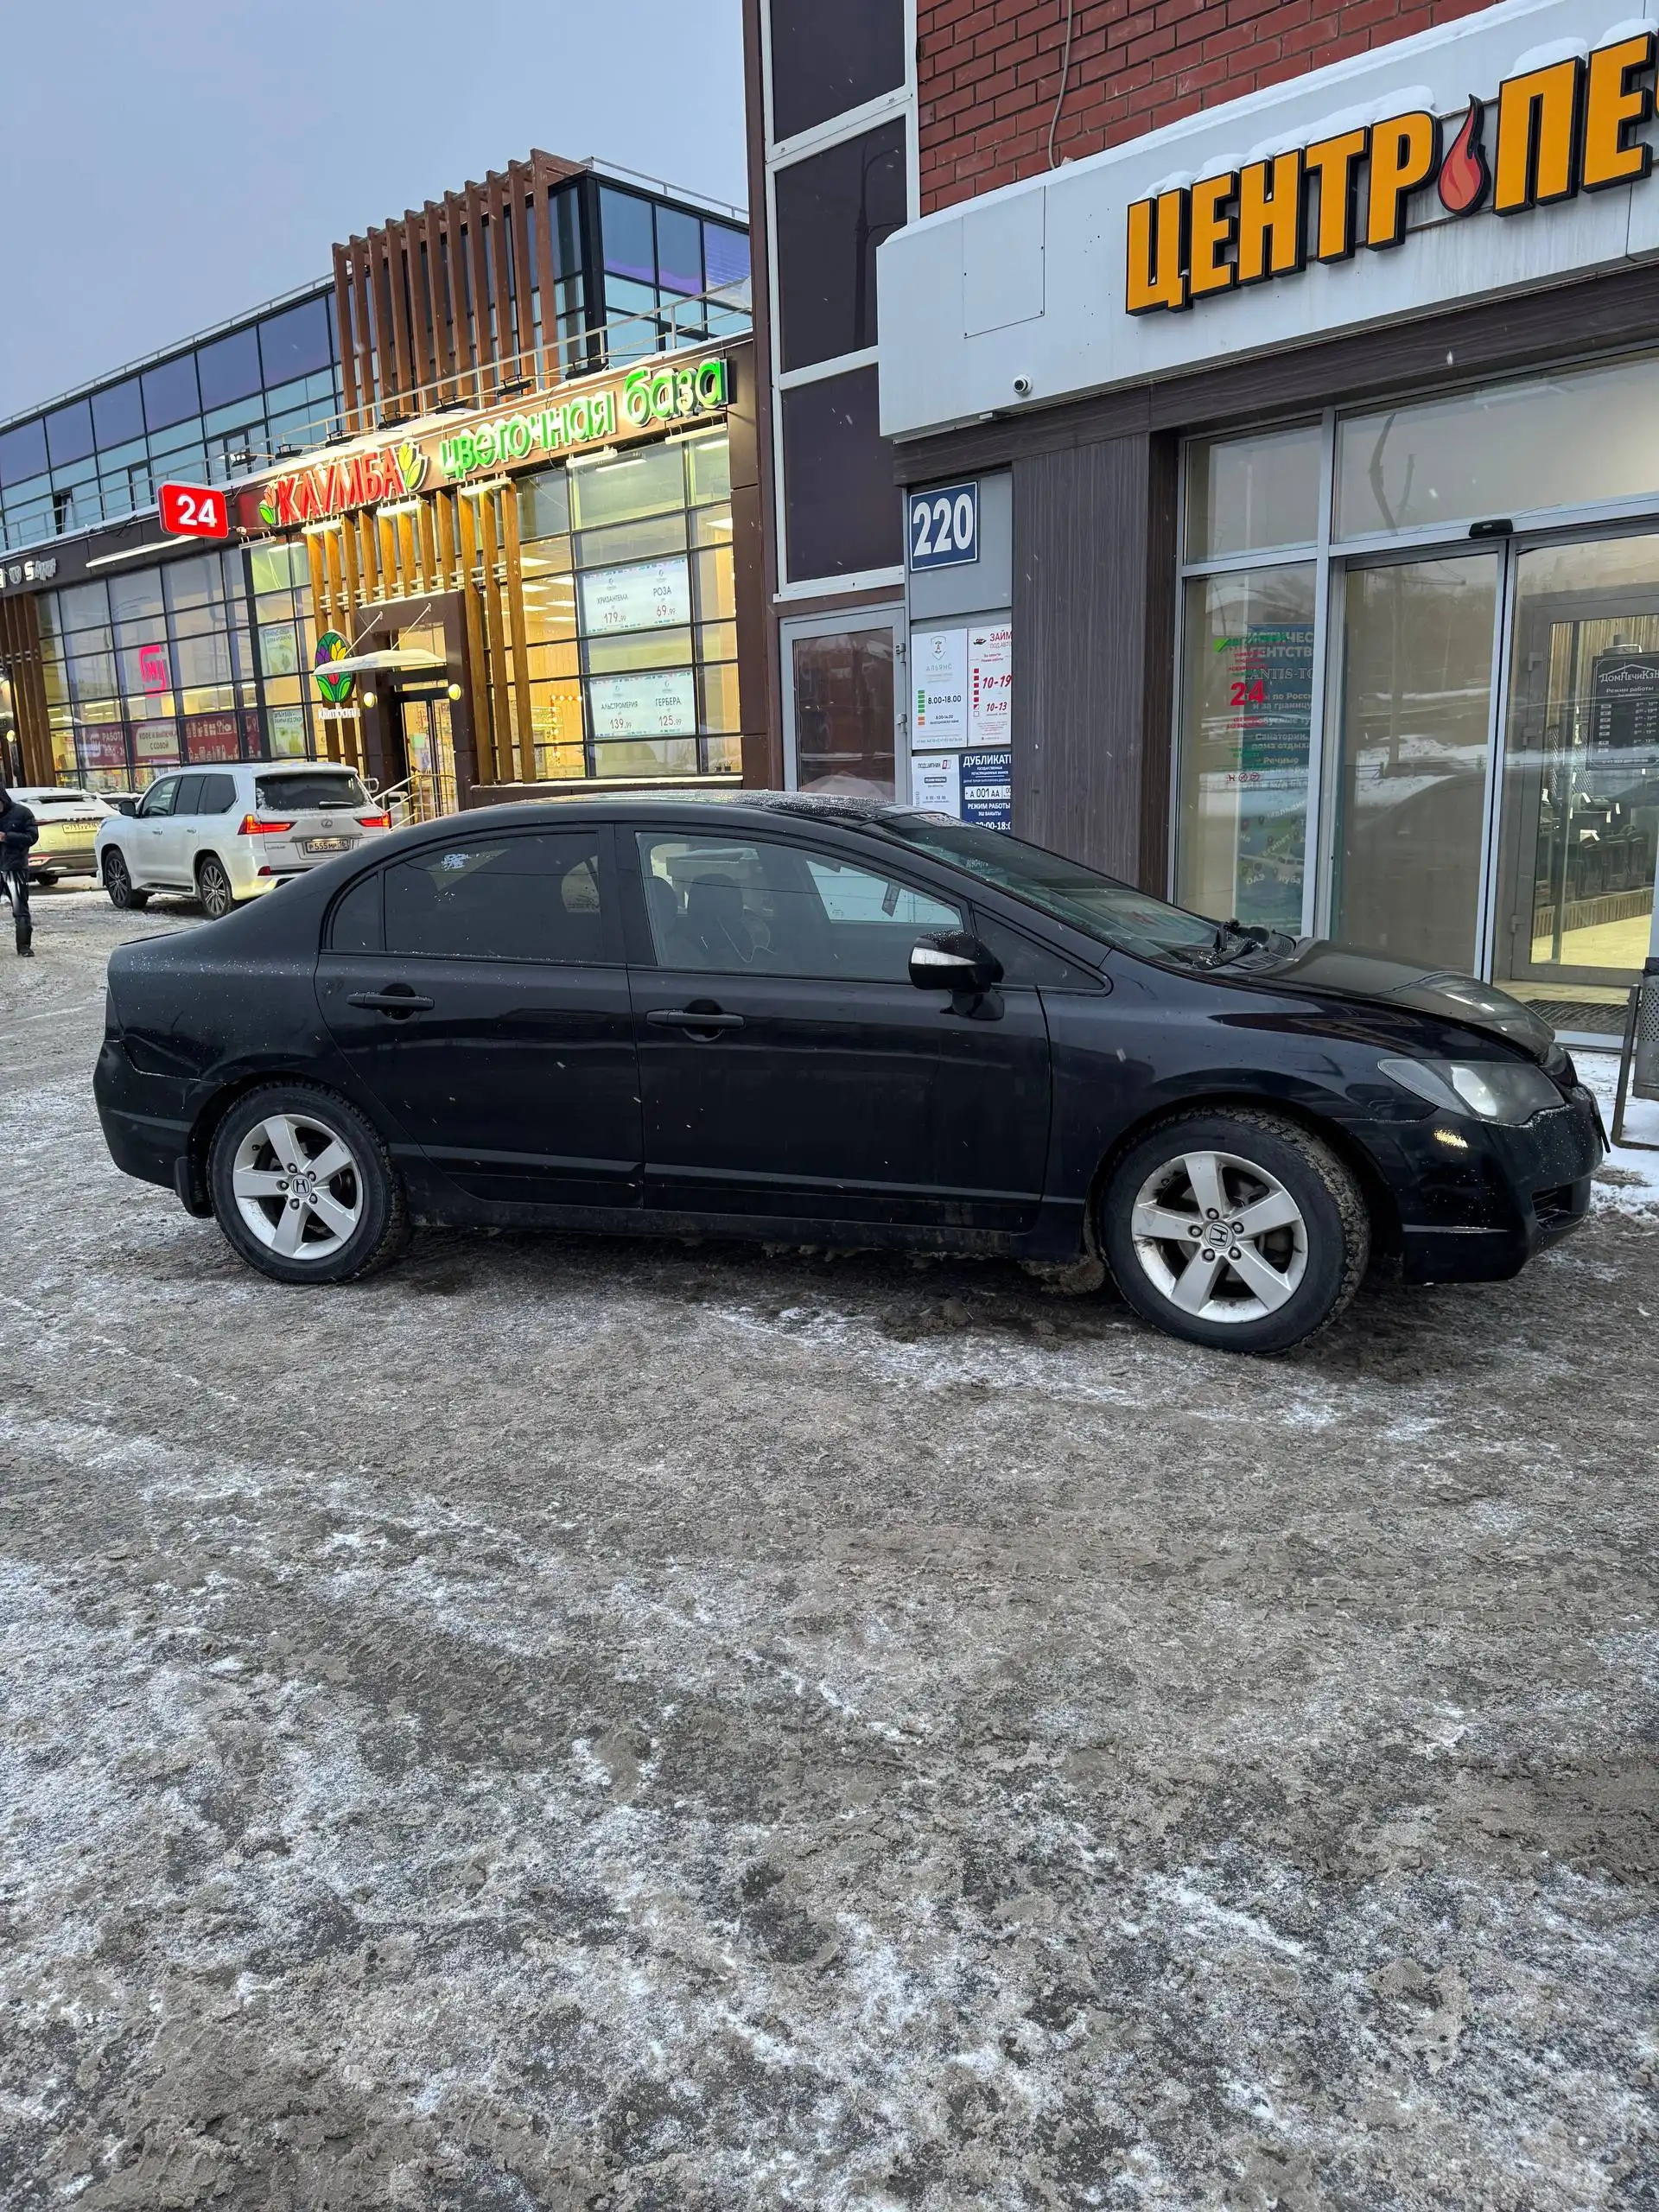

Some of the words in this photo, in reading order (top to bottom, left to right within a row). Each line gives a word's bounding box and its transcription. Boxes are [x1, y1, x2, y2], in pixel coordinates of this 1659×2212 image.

[1126, 110, 1443, 316] ЦЕНТР
[1493, 31, 1659, 216] ПЕ
[276, 447, 406, 527] КЛУМБА
[439, 391, 617, 479] цветочная
[622, 358, 728, 428] база
[176, 494, 218, 528] 24
[912, 493, 974, 556] 220
[653, 586, 672, 597] РОЗА
[596, 594, 629, 605] ХРИЗАНТЕМА
[925, 663, 952, 672] АЛЬЯНС
[982, 674, 1014, 690] 10-19
[1230, 679, 1266, 706] 24
[601, 700, 639, 710] АЛЬСТРОМЕРИЯ
[655, 696, 682, 707] ГЕРБЕРА
[927, 695, 962, 705] 8.00-18.00
[986, 702, 1007, 712] 10-13
[1245, 873, 1266, 886] ОАЭ
